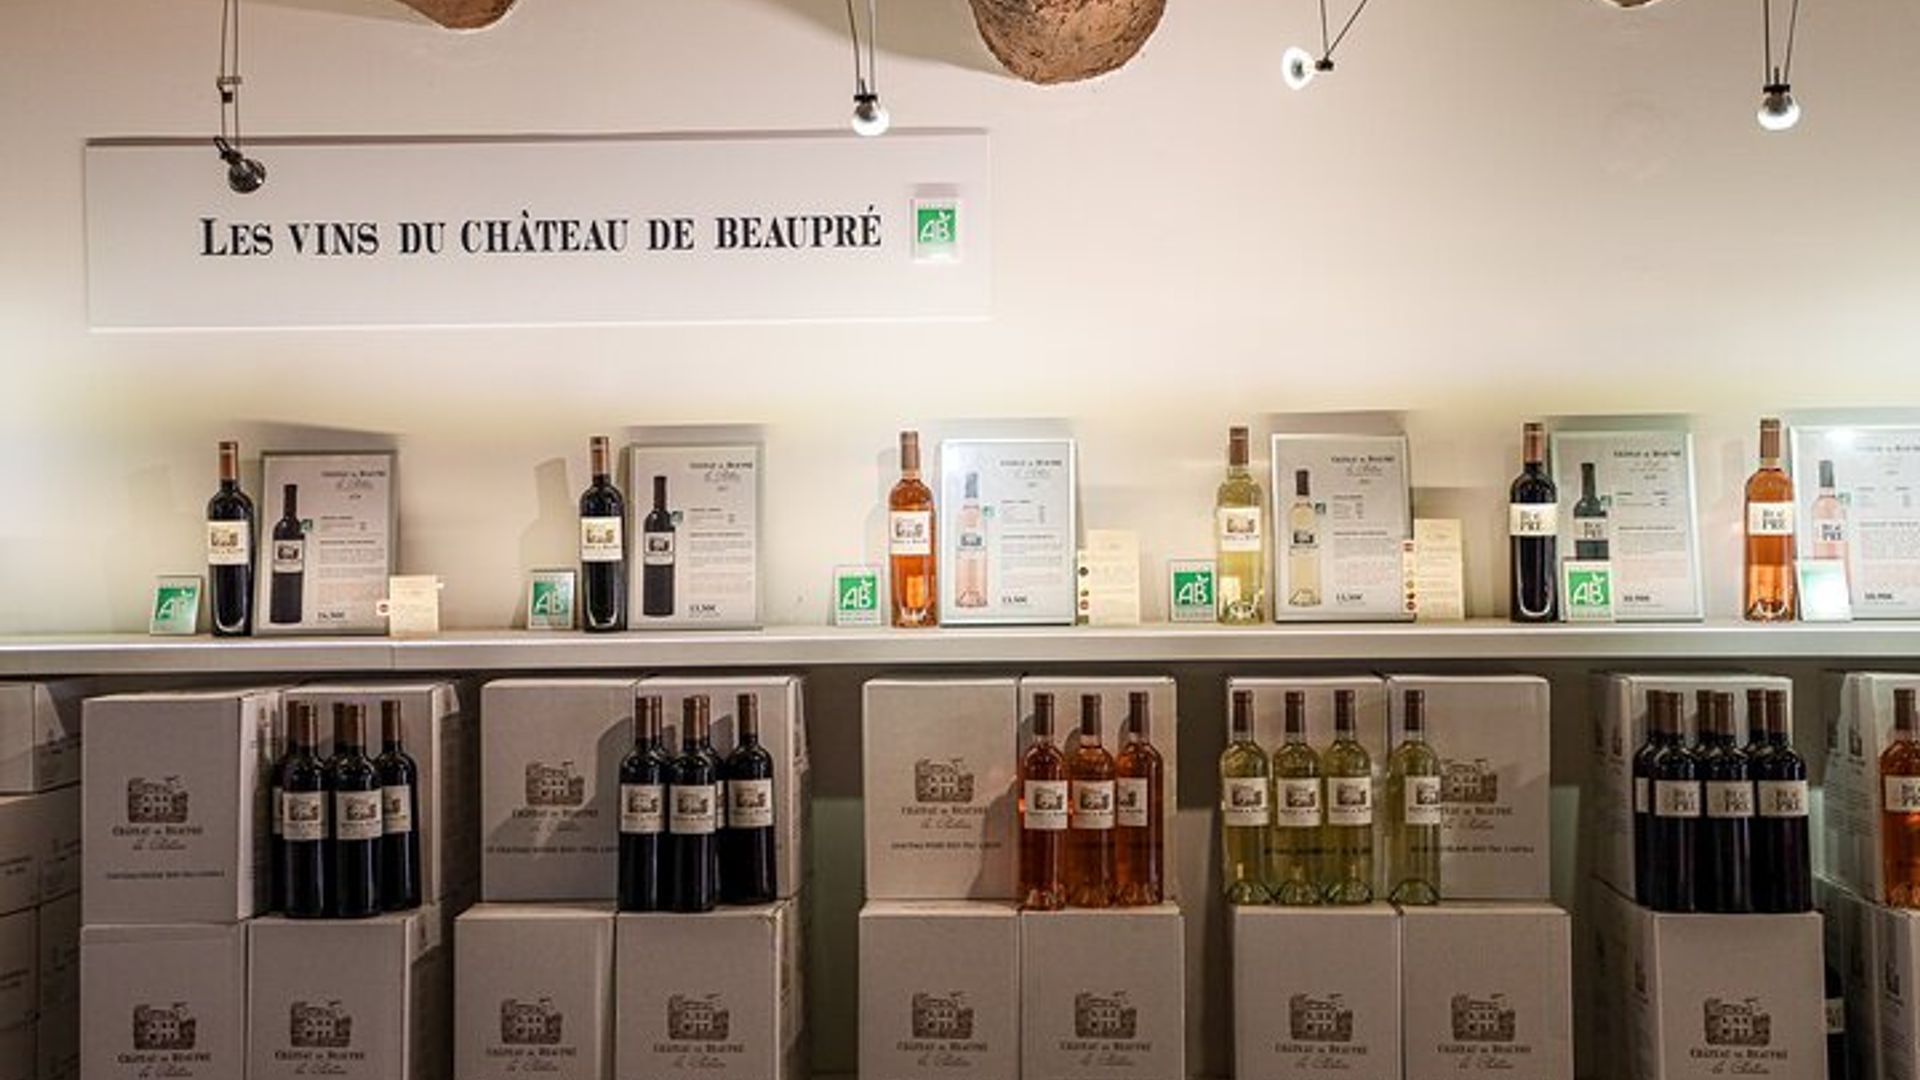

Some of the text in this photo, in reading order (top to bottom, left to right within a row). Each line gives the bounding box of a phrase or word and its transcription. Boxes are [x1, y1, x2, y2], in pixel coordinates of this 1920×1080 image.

[201, 218, 274, 256] LES
[288, 222, 380, 256] VINS
[398, 222, 446, 254] DU
[648, 218, 694, 250] DE
[716, 204, 881, 249] BEAUPRÉ
[920, 219, 951, 242] AB
